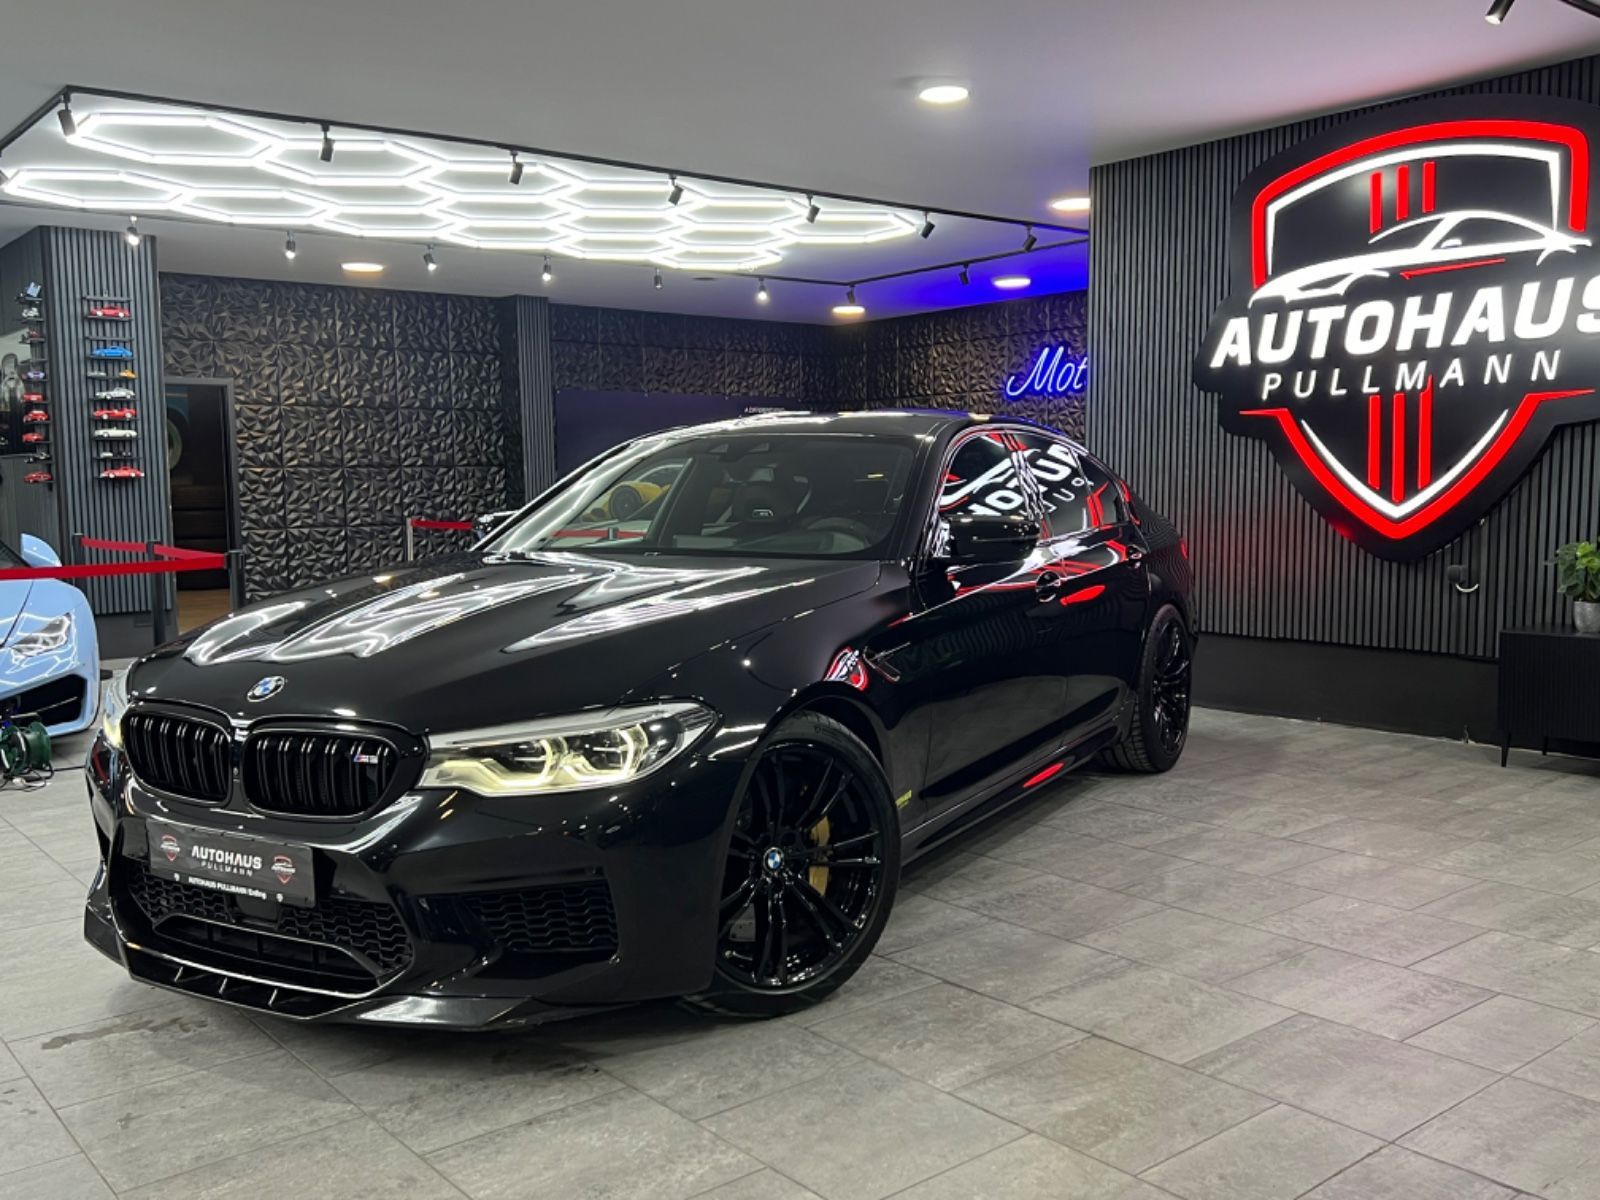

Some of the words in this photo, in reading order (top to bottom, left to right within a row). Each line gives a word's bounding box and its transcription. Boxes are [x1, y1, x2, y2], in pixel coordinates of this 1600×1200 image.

[1006, 346, 1088, 396] Mot
[1262, 349, 1562, 400] PULLMANN
[191, 845, 263, 869] AUTOHAUS
[201, 861, 253, 877] PULLMANN
